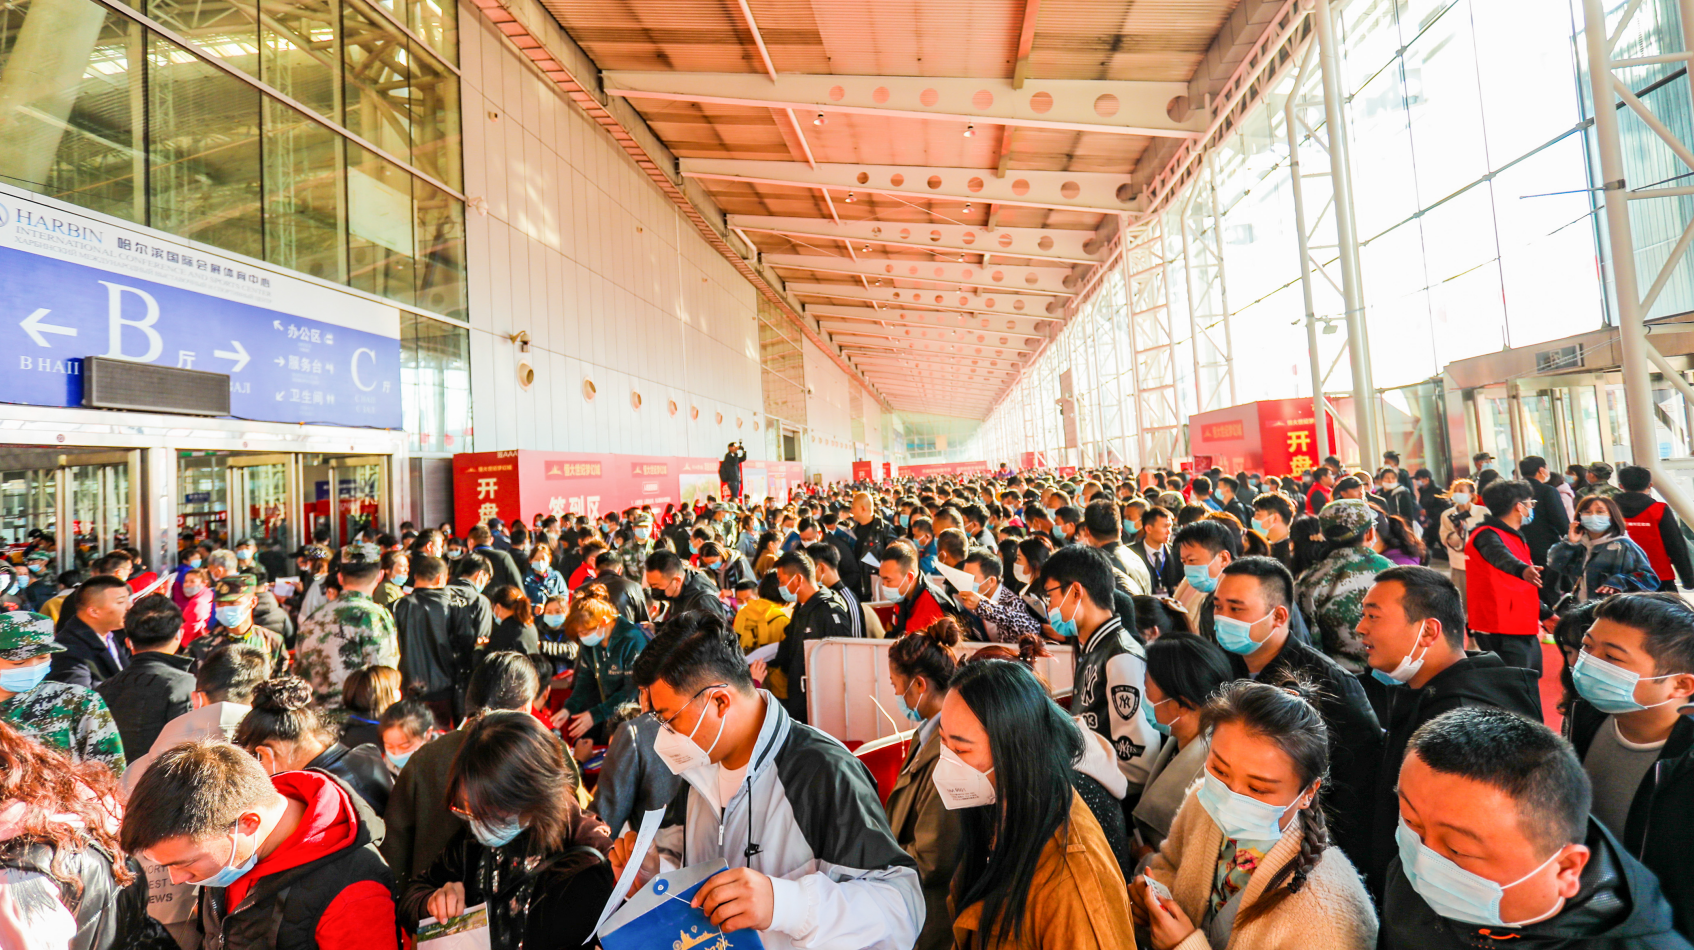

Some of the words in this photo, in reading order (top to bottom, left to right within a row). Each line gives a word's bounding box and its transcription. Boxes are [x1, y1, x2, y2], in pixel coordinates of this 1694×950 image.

[16, 208, 103, 243] HARBIN
[16, 226, 117, 258] INTERNATIONAL
[118, 252, 187, 275] CONFERENCE
[117, 236, 270, 288] 哈尔滨国际会展体育中心
[97, 279, 164, 363] B
[178, 350, 196, 369] 厅
[288, 323, 322, 344] 办公区
[20, 355, 33, 370] B
[288, 354, 322, 374] 服务台
[350, 347, 377, 392] C
[289, 388, 324, 406] 卫生间
[1287, 430, 1312, 477] 开盘
[476, 477, 499, 524] 开盘
[149, 878, 168, 889] EST
[149, 893, 173, 904] EWS
